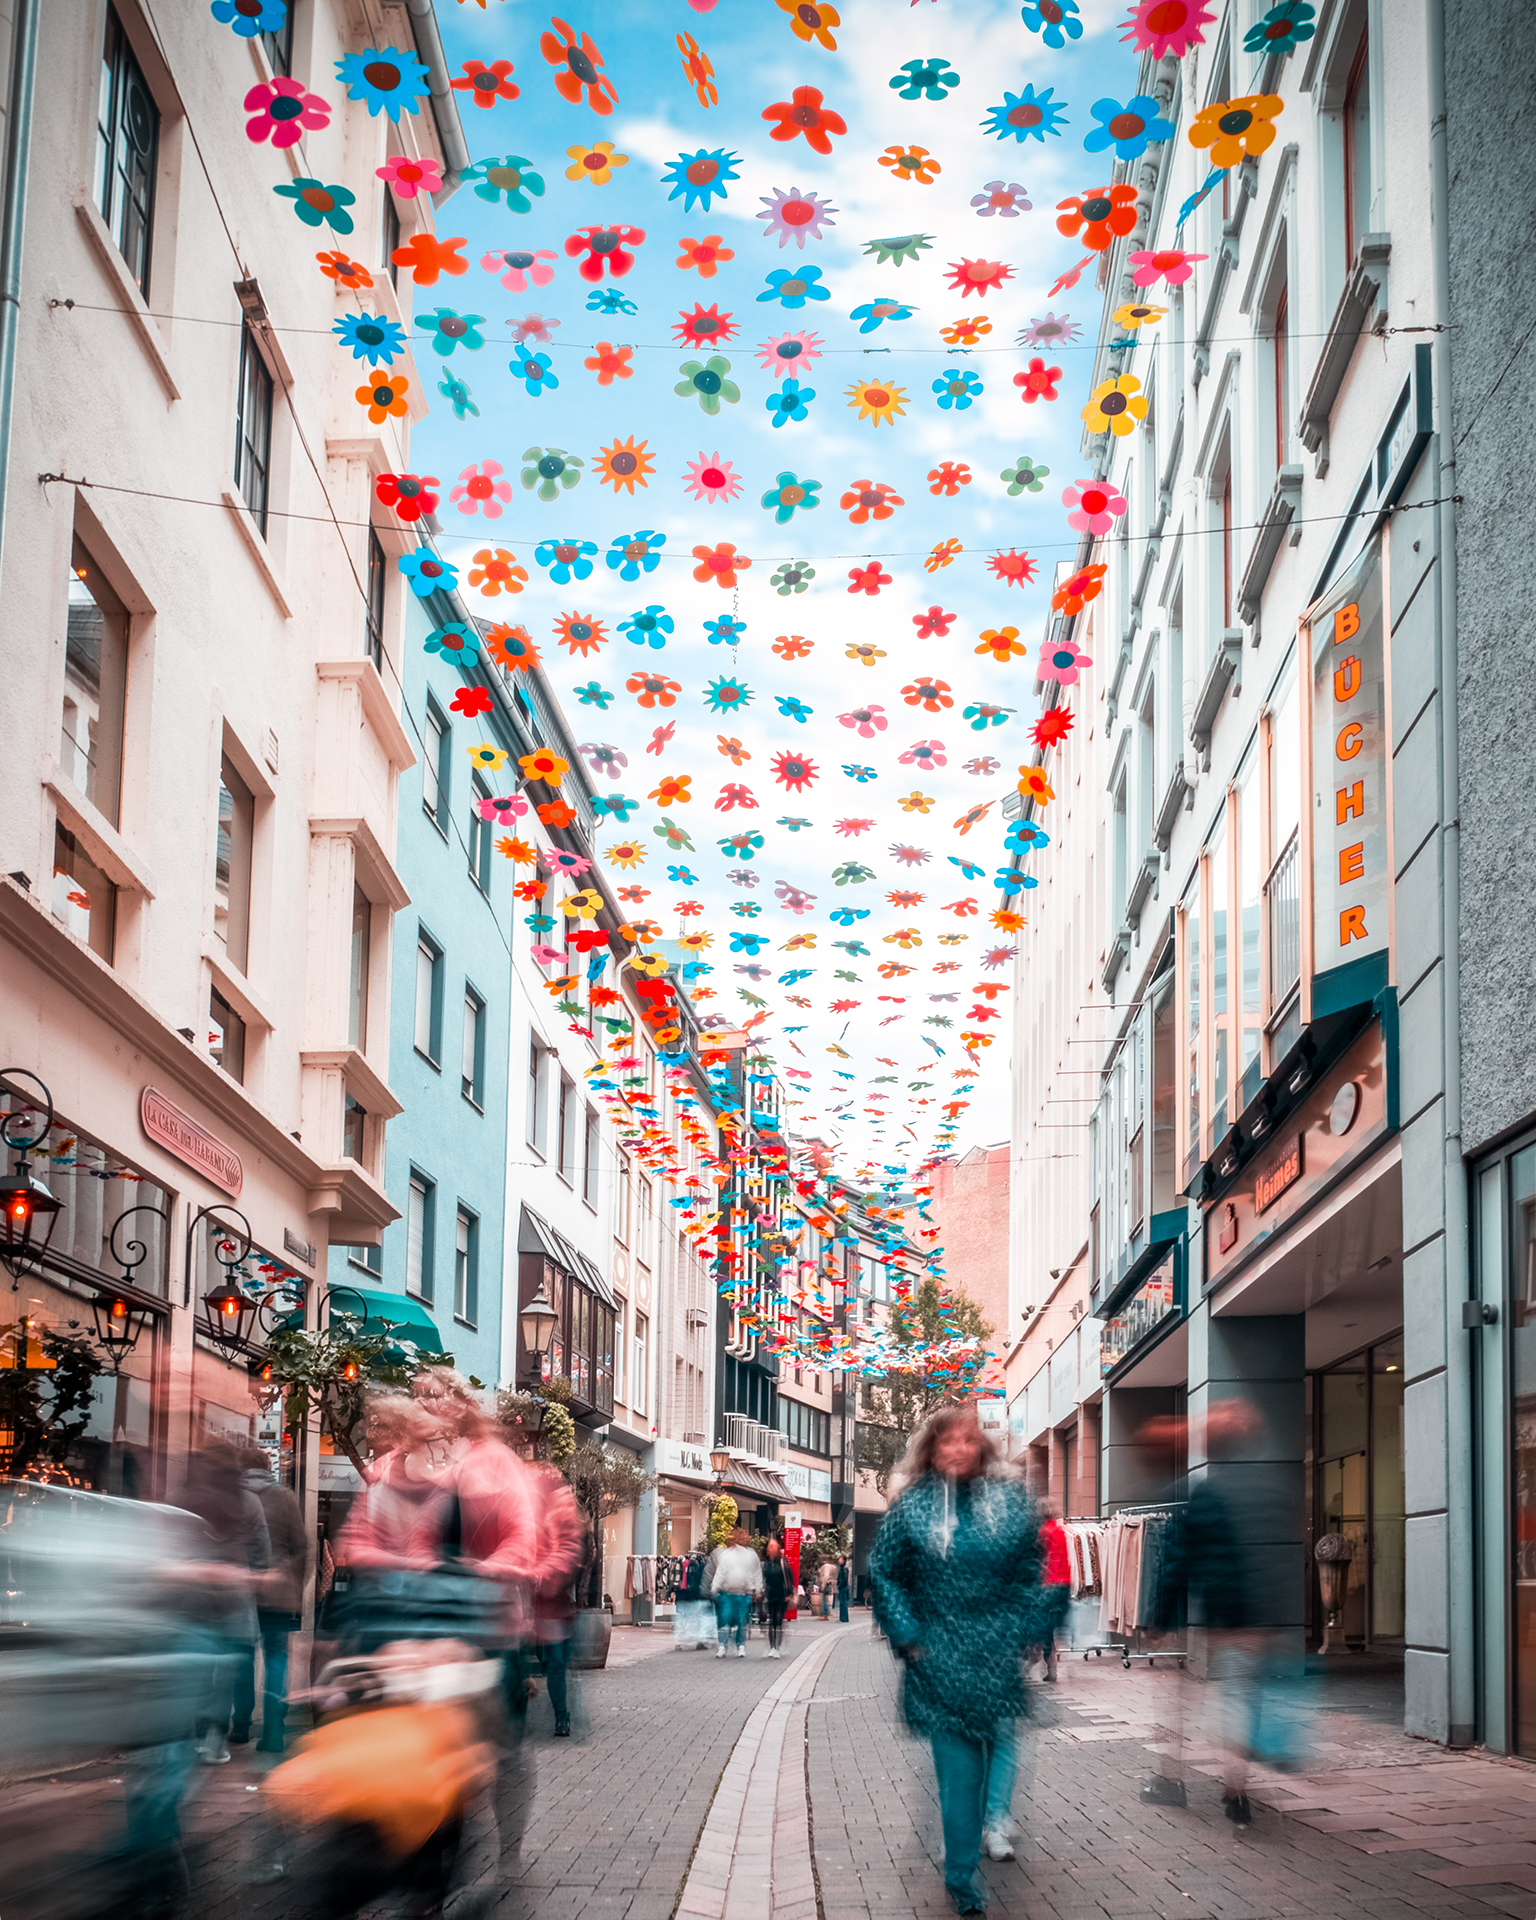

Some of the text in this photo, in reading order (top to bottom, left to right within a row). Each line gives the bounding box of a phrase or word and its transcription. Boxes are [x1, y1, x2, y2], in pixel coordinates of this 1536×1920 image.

[1333, 602, 1369, 947] BÜCHER
[147, 1104, 225, 1173] LA CASA DEL HABANO
[1255, 1151, 1298, 1214] Heimes
